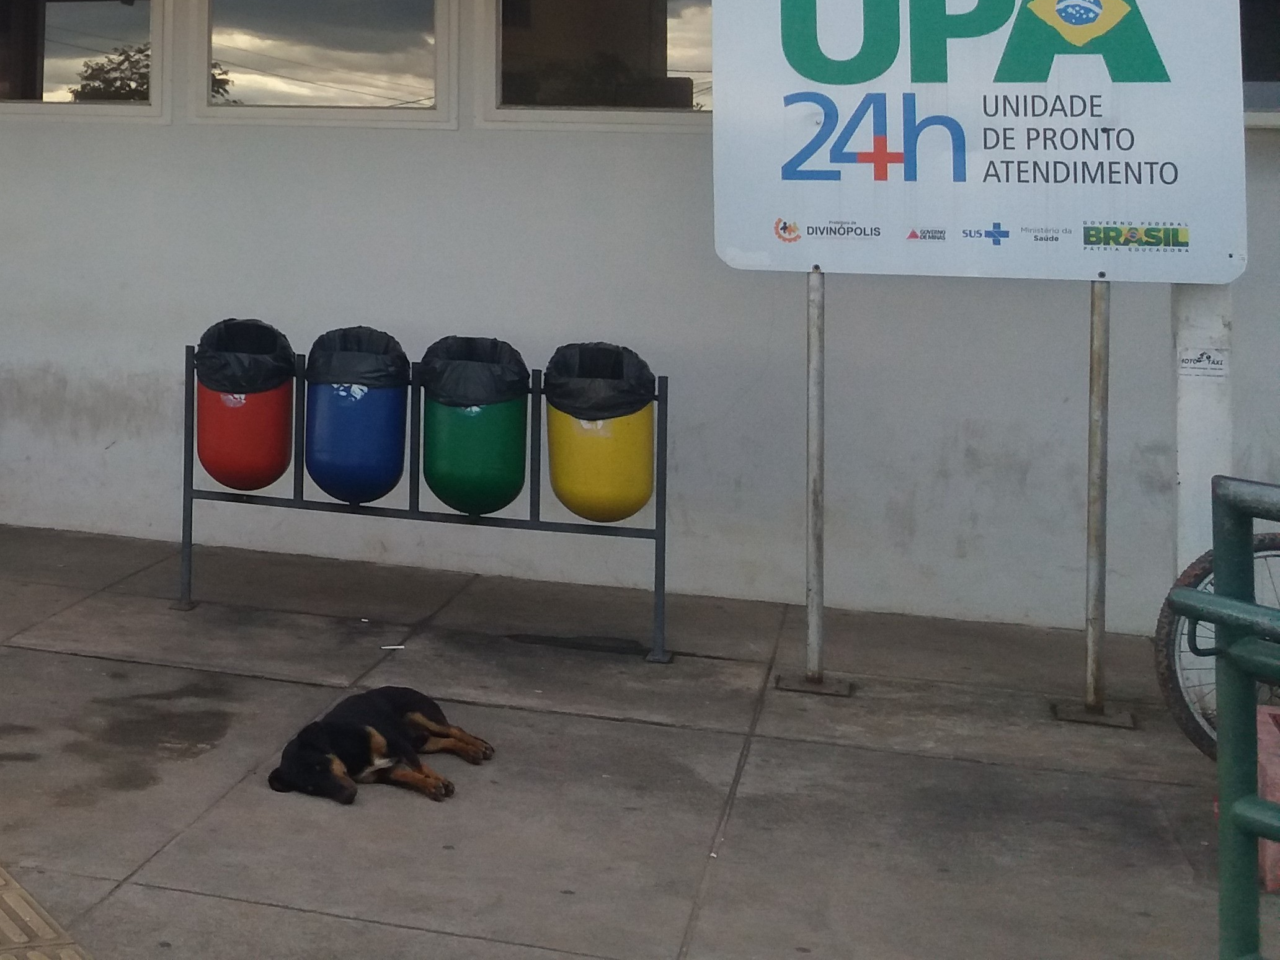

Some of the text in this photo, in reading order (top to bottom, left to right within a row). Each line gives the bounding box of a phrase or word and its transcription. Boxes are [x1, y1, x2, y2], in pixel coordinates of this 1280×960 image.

[983, 95, 1103, 118] UNIDADE
[781, 91, 967, 183] 24h
[983, 127, 1135, 151] DE PRONTO
[982, 160, 1179, 185] ATENDIMENTO
[807, 224, 881, 237] DIVINÓPOLIS
[962, 229, 983, 238] SUS
[1033, 234, 1060, 242] Saúde
[1061, 227, 1073, 235] da
[1083, 226, 1189, 247] BRASIL
